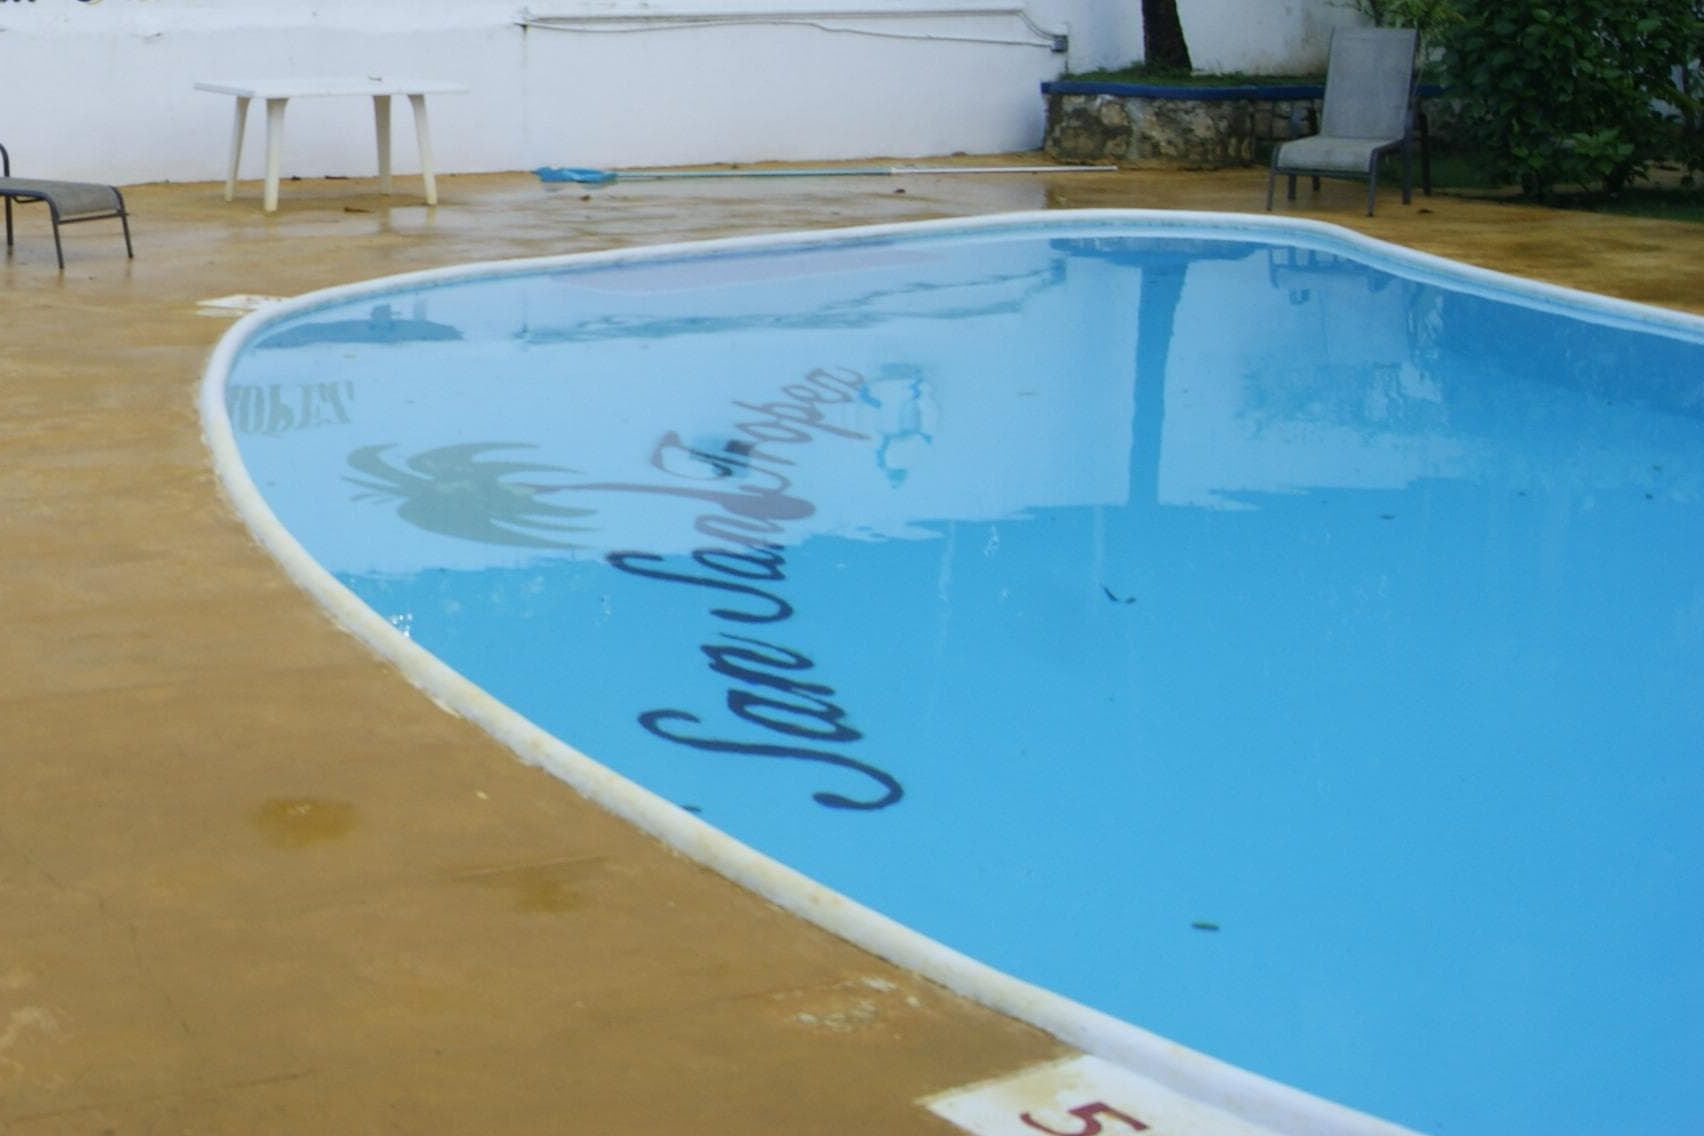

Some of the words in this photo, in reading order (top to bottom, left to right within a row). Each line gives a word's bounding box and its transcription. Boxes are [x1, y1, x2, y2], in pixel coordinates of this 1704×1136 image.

[605, 511, 795, 625] San
[637, 631, 905, 811] San
[1019, 1101, 1151, 1136] 5
